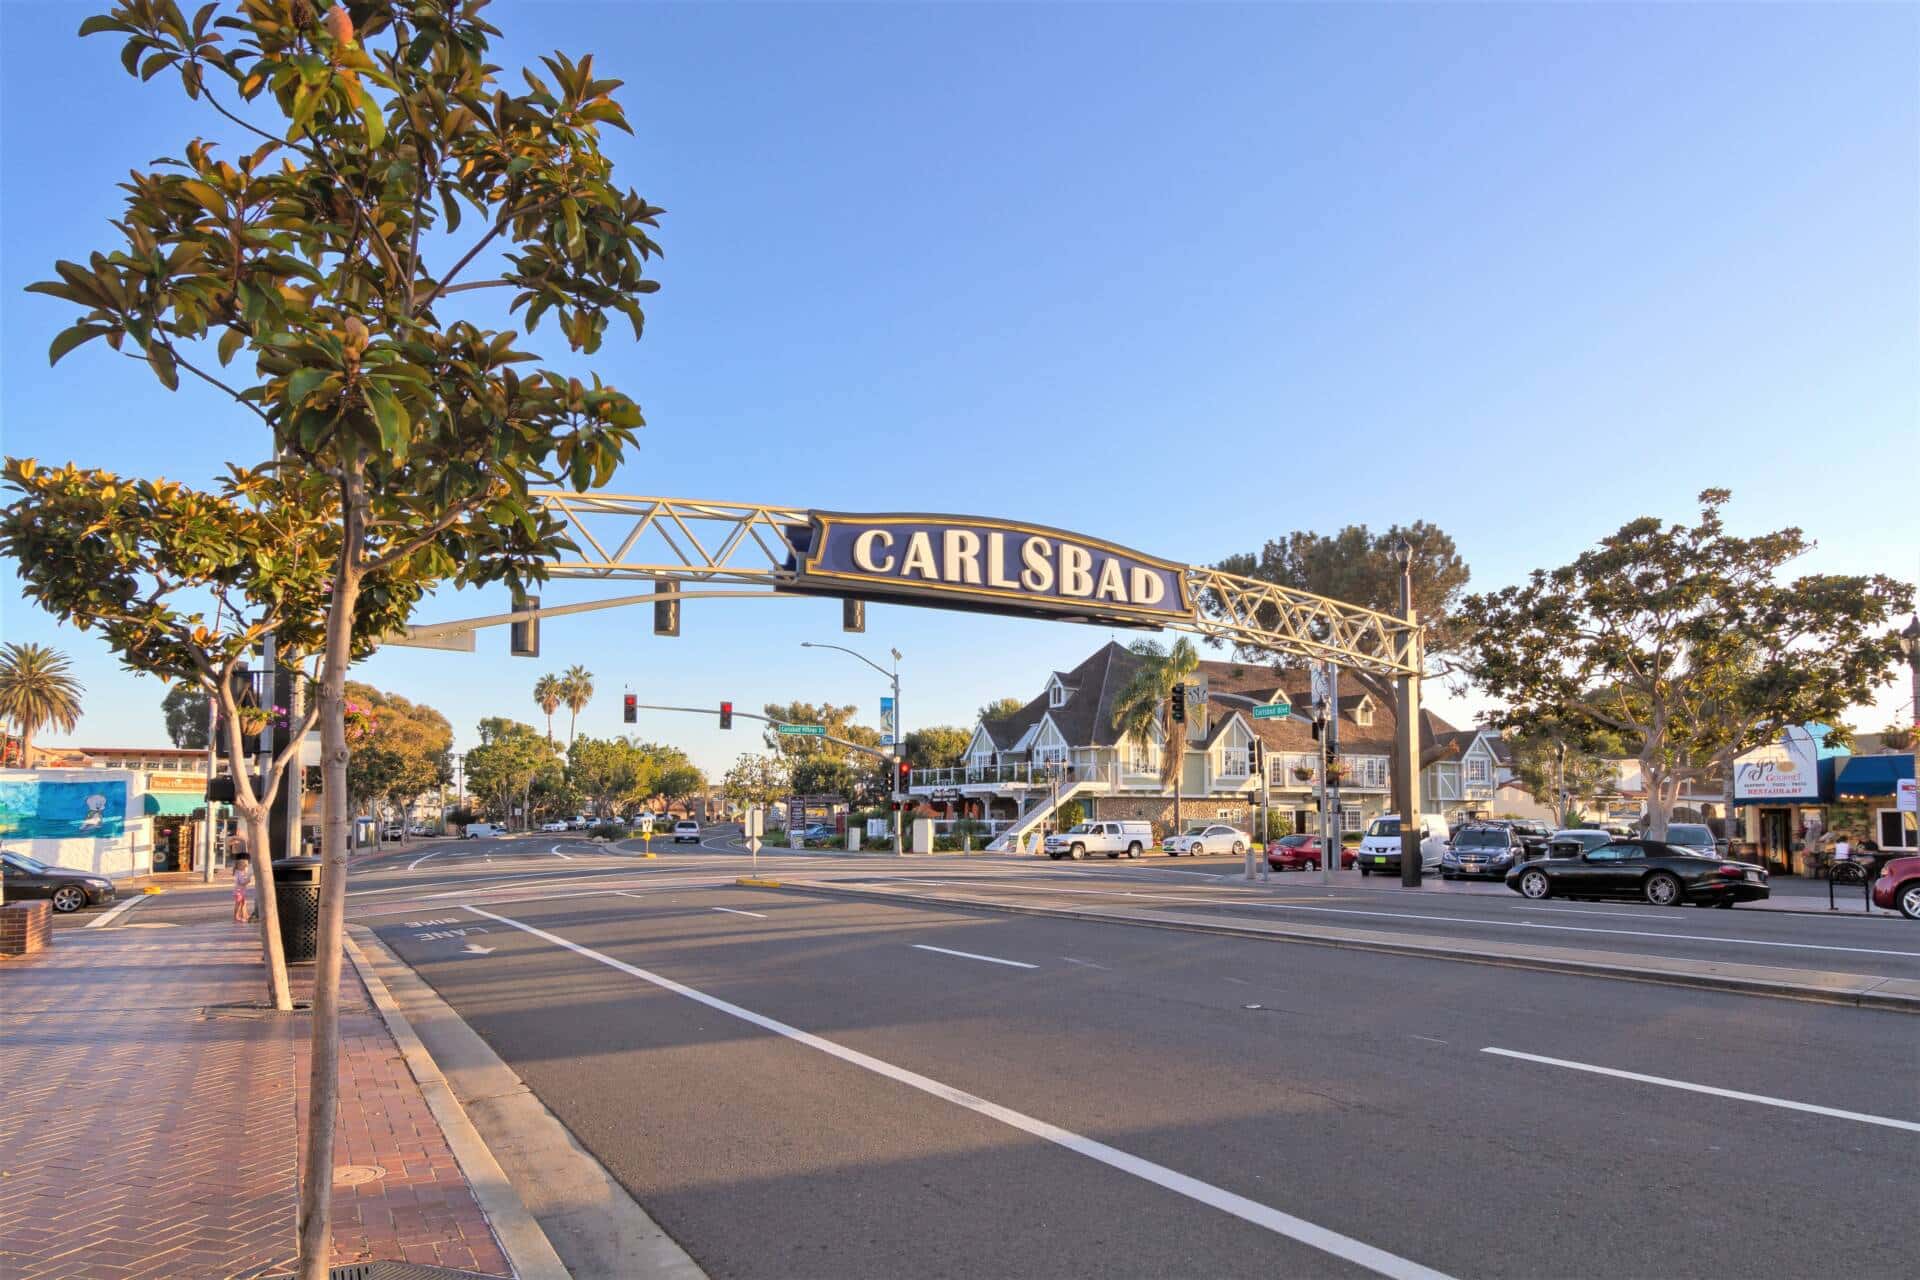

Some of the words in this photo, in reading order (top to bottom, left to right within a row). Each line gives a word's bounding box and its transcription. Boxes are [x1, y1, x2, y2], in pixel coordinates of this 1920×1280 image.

[853, 529, 1165, 605] CARLSBAD
[1255, 708, 1275, 716] Carlsbad
[1277, 706, 1288, 714] Blvd
